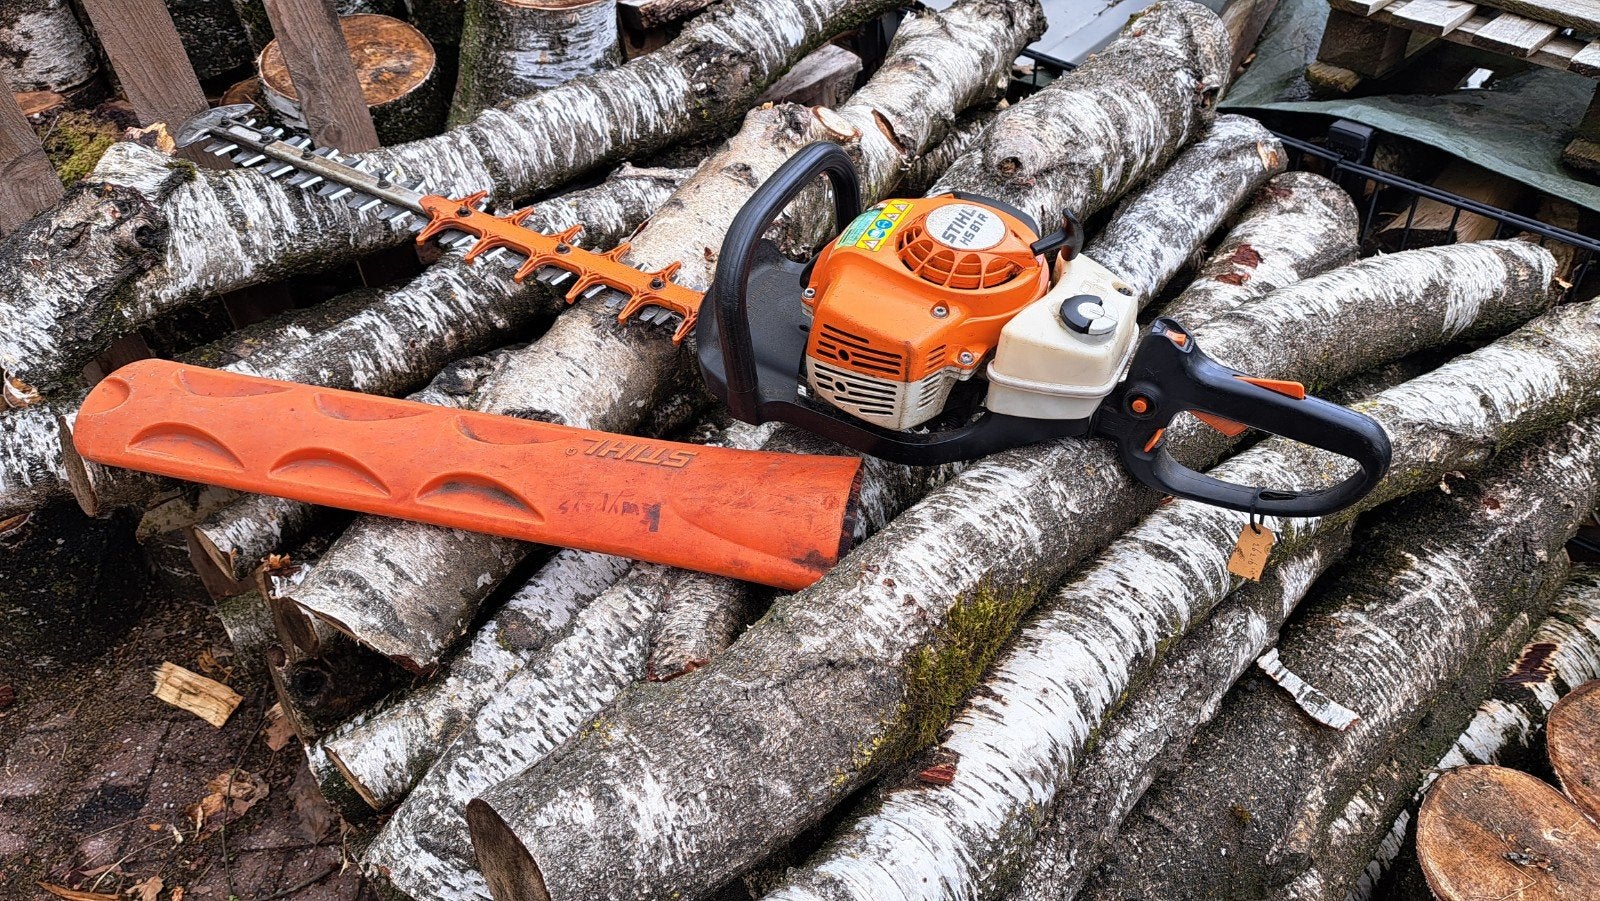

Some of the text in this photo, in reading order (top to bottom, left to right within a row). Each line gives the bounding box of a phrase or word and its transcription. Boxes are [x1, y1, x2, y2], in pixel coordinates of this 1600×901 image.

[941, 209, 977, 244] STIHL
[959, 213, 989, 246] HS 81 R
[583, 438, 699, 468] STIHL
